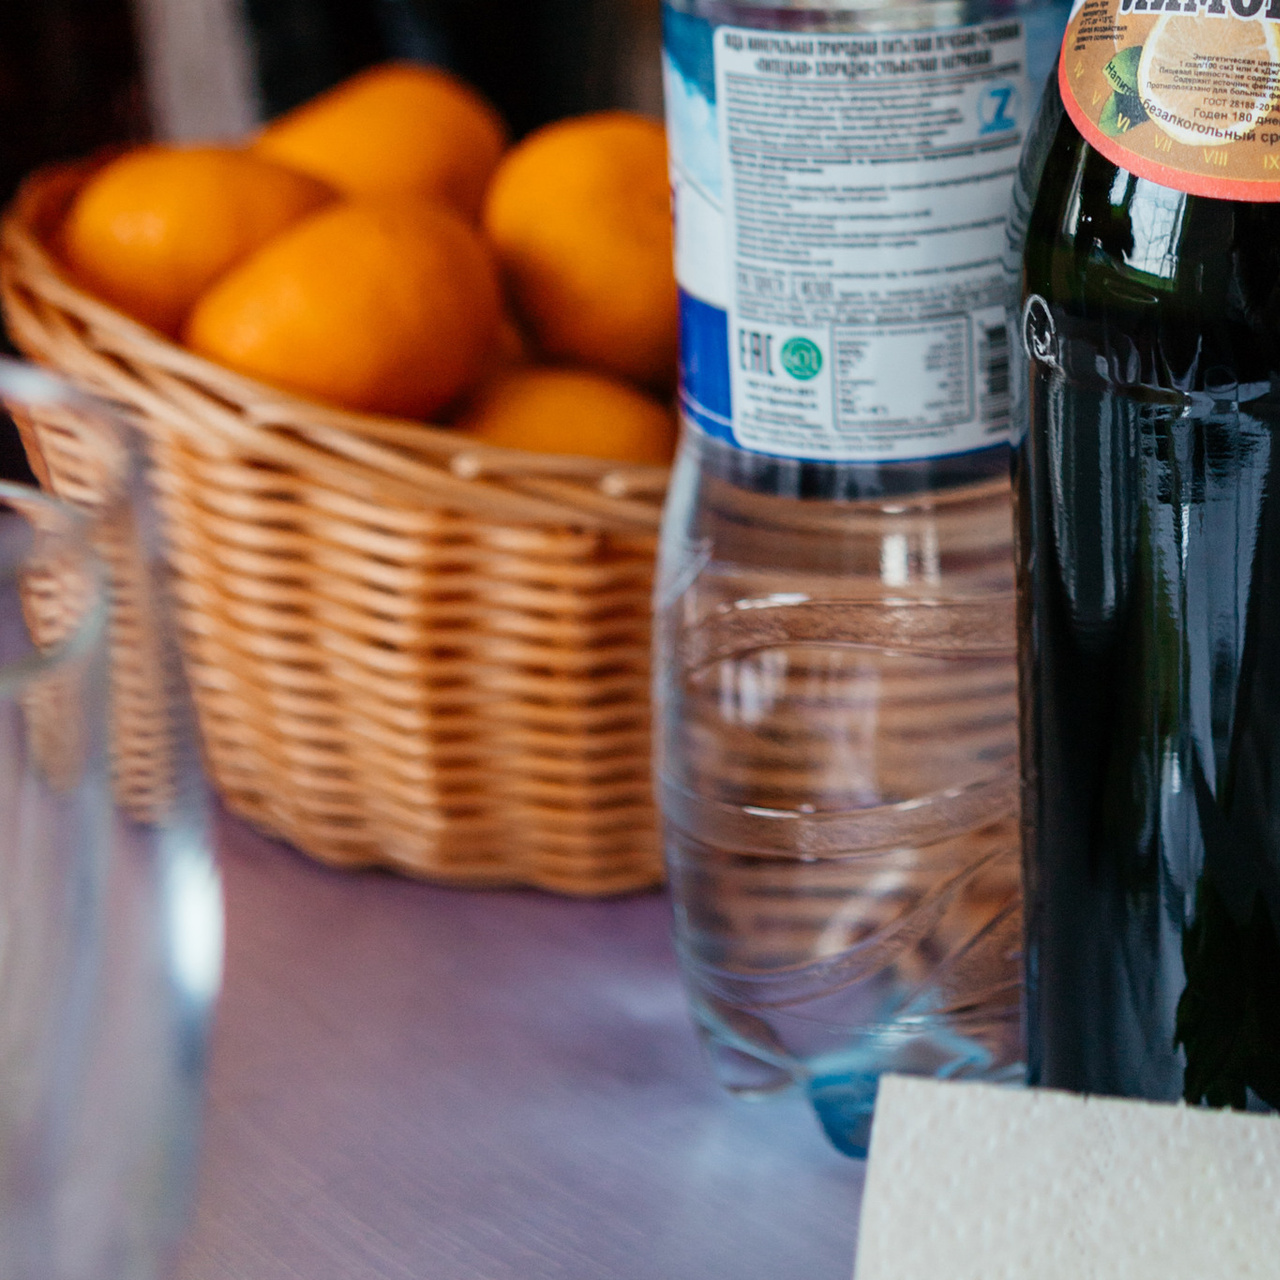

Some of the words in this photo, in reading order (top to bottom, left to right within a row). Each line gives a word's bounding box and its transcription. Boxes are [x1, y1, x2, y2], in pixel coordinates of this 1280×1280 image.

[1193, 53, 1255, 66] Энергетическая
[1159, 66, 1192, 77] Пищевая
[1173, 74, 1211, 86] Содержит
[1213, 78, 1249, 89] источник
[1146, 81, 1212, 93] Противопоказано
[1212, 86, 1228, 96] для
[1229, 87, 1267, 98] больных
[1105, 61, 1141, 100] Напито
[1143, 98, 1256, 142] безалкогольный
[1203, 97, 1226, 107] ГОСТ
[1193, 107, 1228, 121] Годен
[1232, 110, 1252, 123] 180
[1117, 112, 1131, 133] VI
[1154, 133, 1173, 153] VII
[1203, 148, 1228, 167] VIII
[1264, 154, 1280, 170] IX
